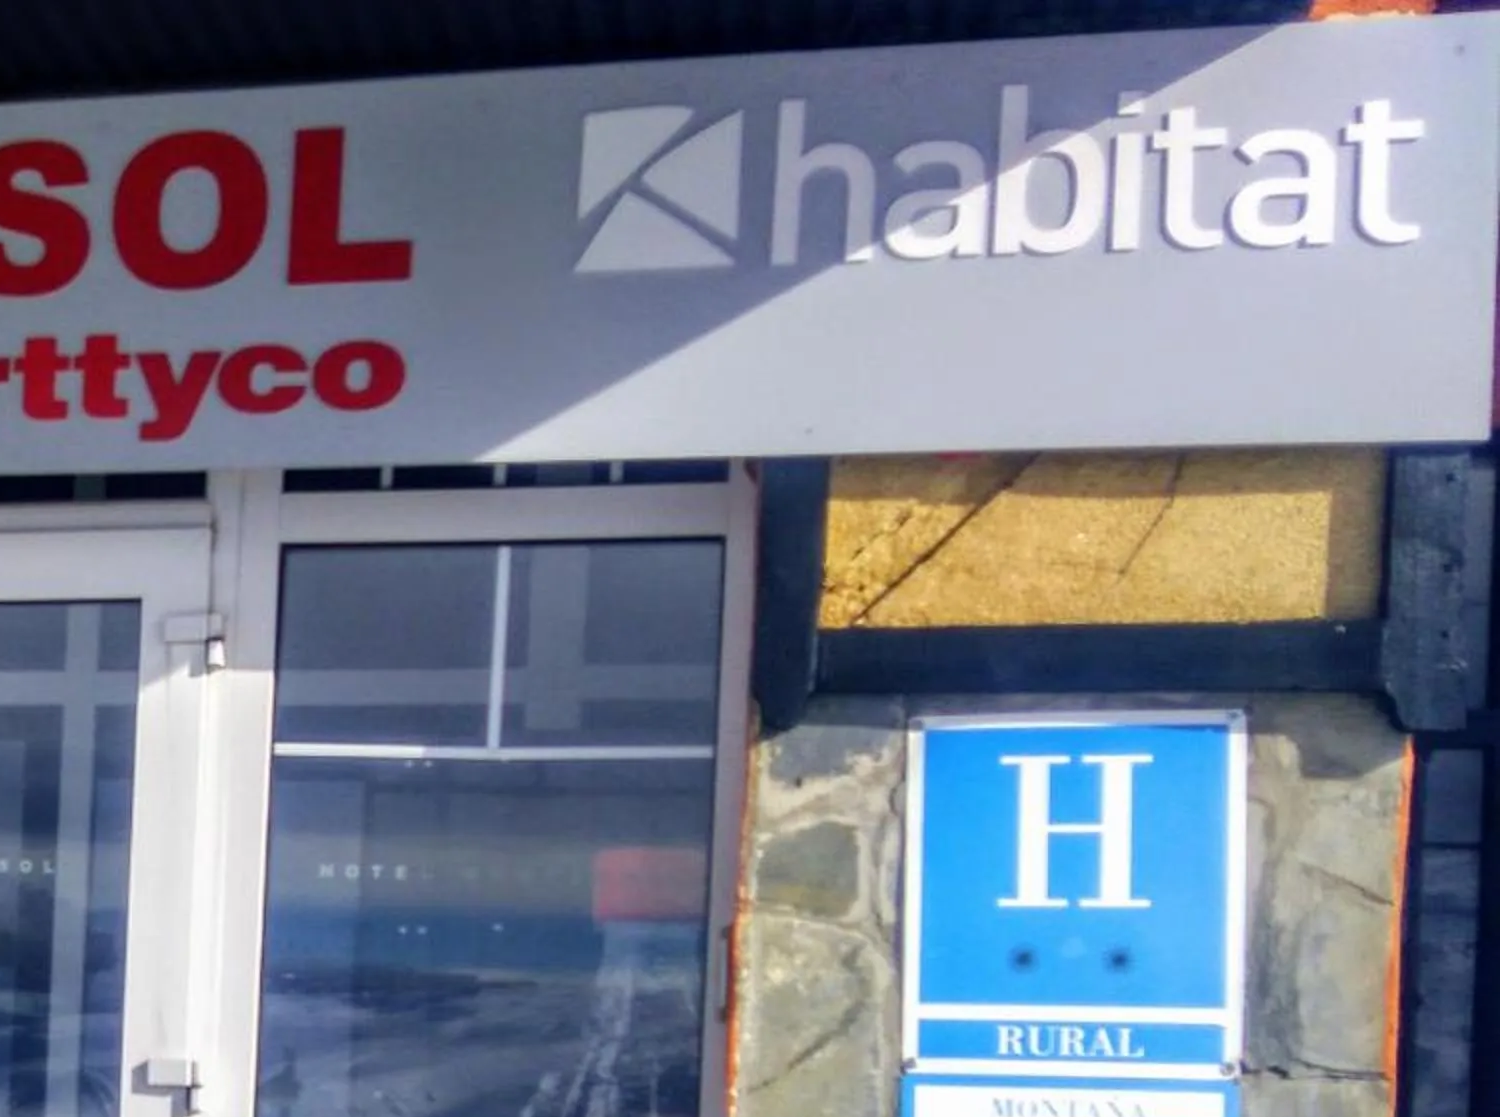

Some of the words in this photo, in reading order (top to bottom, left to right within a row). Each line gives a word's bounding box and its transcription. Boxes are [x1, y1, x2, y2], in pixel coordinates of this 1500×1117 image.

[770, 84, 1426, 266] habitat
[995, 753, 1154, 908] H
[996, 1024, 1146, 1058] RURAL
